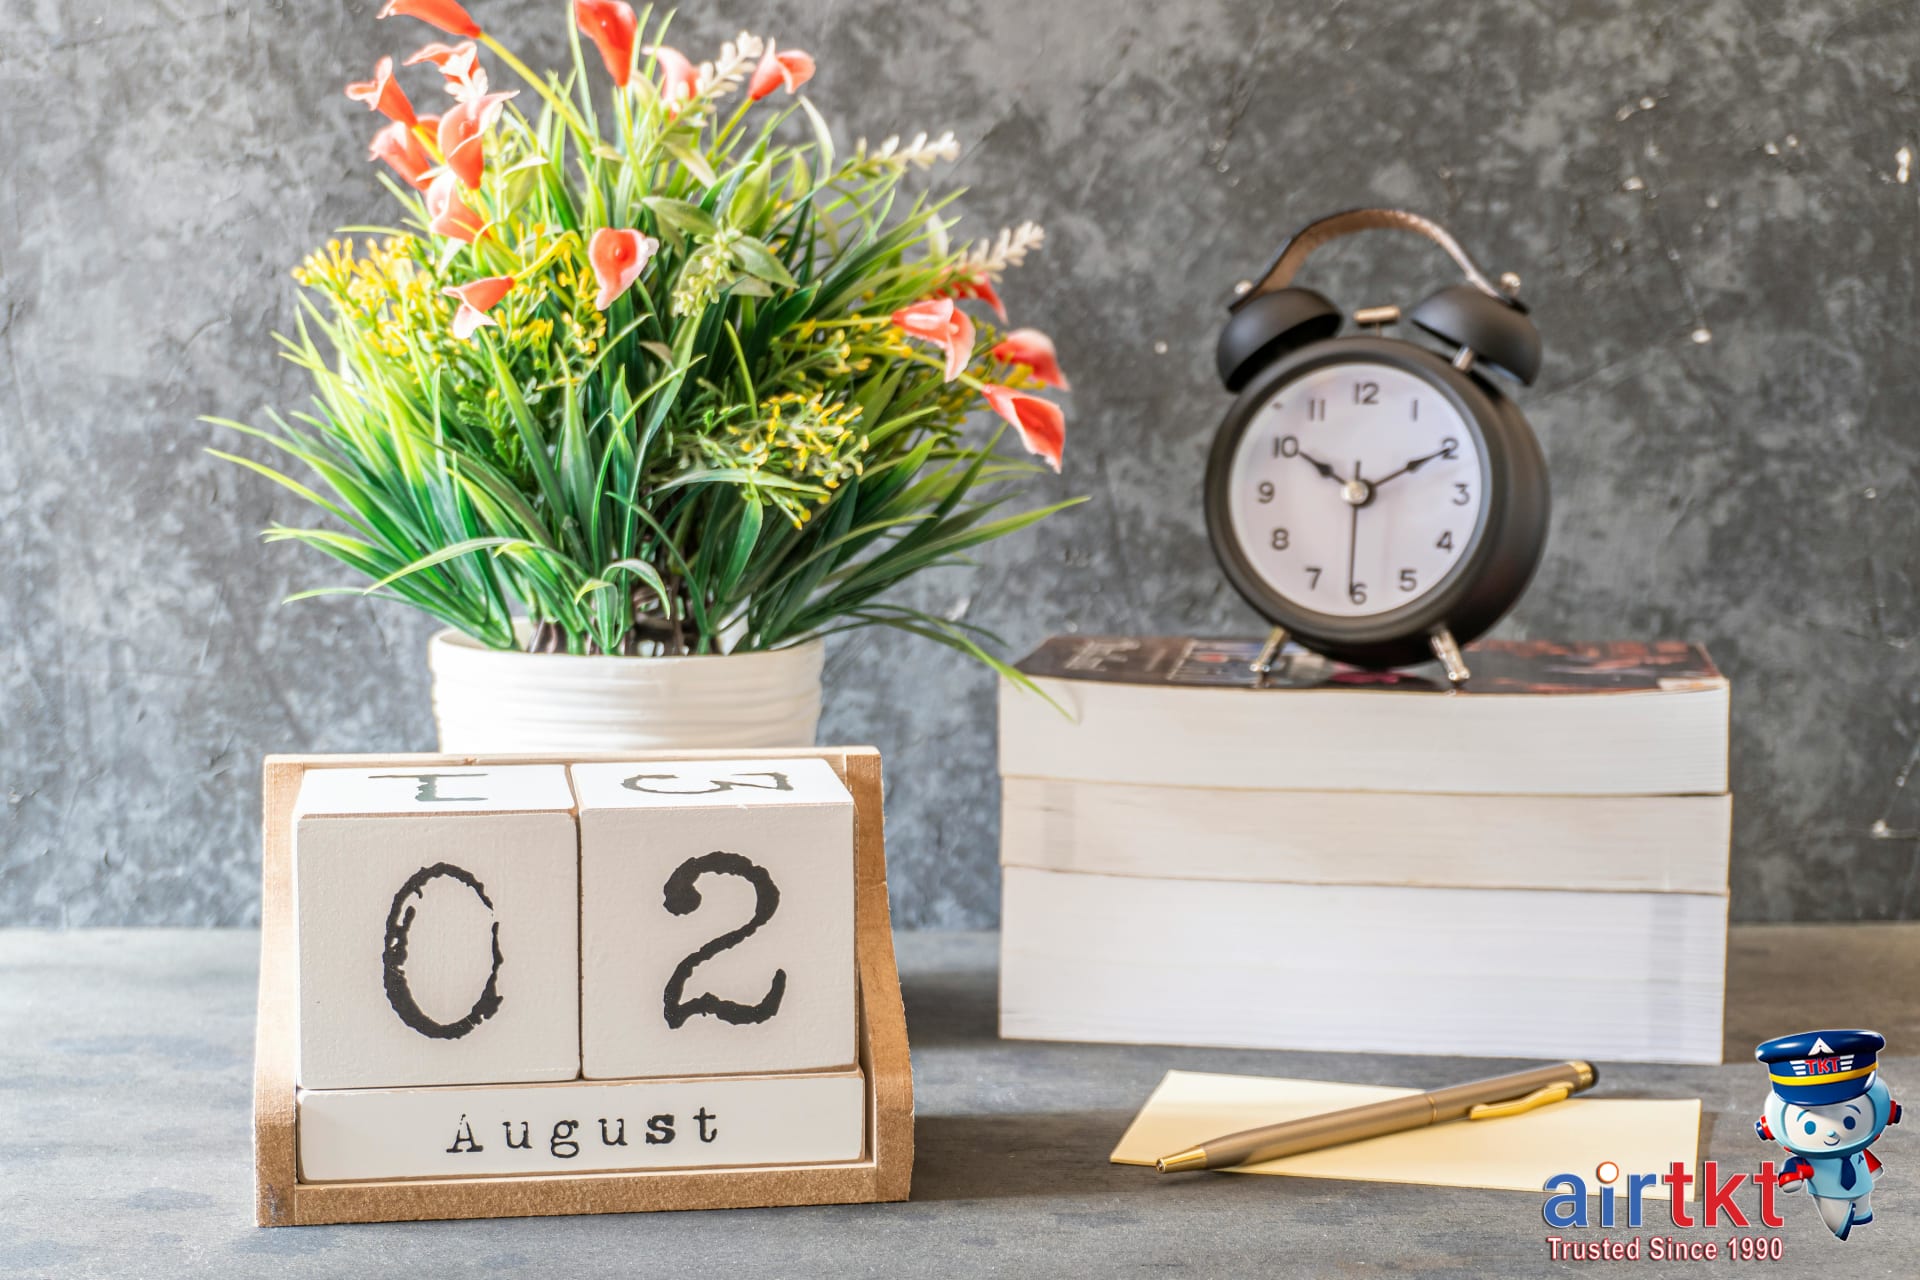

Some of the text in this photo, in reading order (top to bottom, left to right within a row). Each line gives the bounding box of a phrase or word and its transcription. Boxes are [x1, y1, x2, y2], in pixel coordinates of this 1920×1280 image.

[1354, 382, 1380, 405] 12
[1308, 399, 1326, 421] 11
[1411, 399, 1419, 421] 1
[1272, 435, 1300, 459] 10
[1440, 437, 1459, 460] 2
[1257, 482, 1276, 505] 9
[1452, 483, 1471, 506] 3
[1270, 528, 1291, 551] 8
[1435, 531, 1454, 554] 4
[1304, 567, 1323, 591] 7
[1399, 569, 1417, 592] 5
[1350, 582, 1368, 606] 6
[445, 1106, 718, 1159] August
